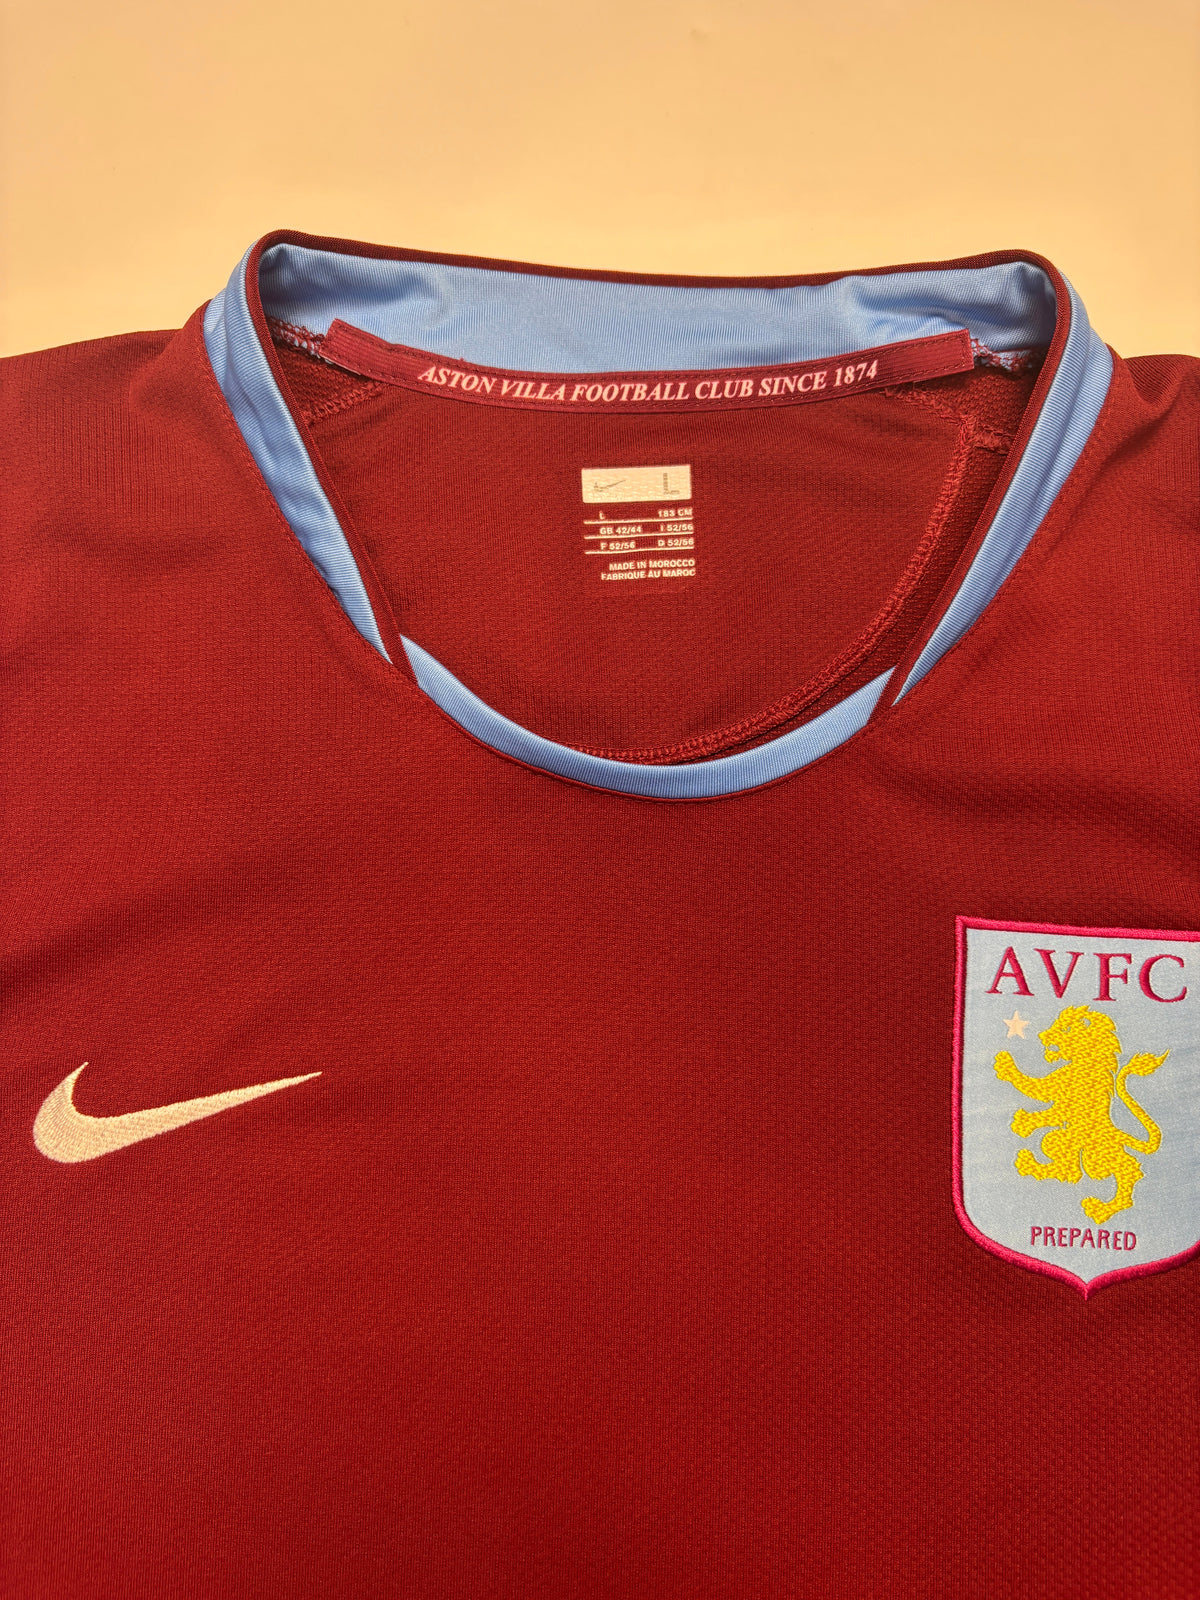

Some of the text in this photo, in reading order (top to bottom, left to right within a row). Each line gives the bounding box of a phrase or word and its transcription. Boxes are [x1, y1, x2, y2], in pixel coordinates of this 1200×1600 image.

[418, 360, 879, 402] ASTON VILLA FOOTBALL CLUB SINCE 1874
[662, 472, 680, 495] L
[599, 507, 693, 520] L 183 CM
[600, 527, 613, 535] GB
[616, 525, 642, 535] 42/44
[667, 523, 694, 532] 52/56
[600, 537, 694, 550] F 52/56 D 52/56
[609, 558, 696, 571] MADE IN MOROCCO
[601, 568, 696, 581] FABRIQUE AU MAROC
[985, 946, 1188, 1003] AVFC
[1031, 1226, 1137, 1251] PREPARED
